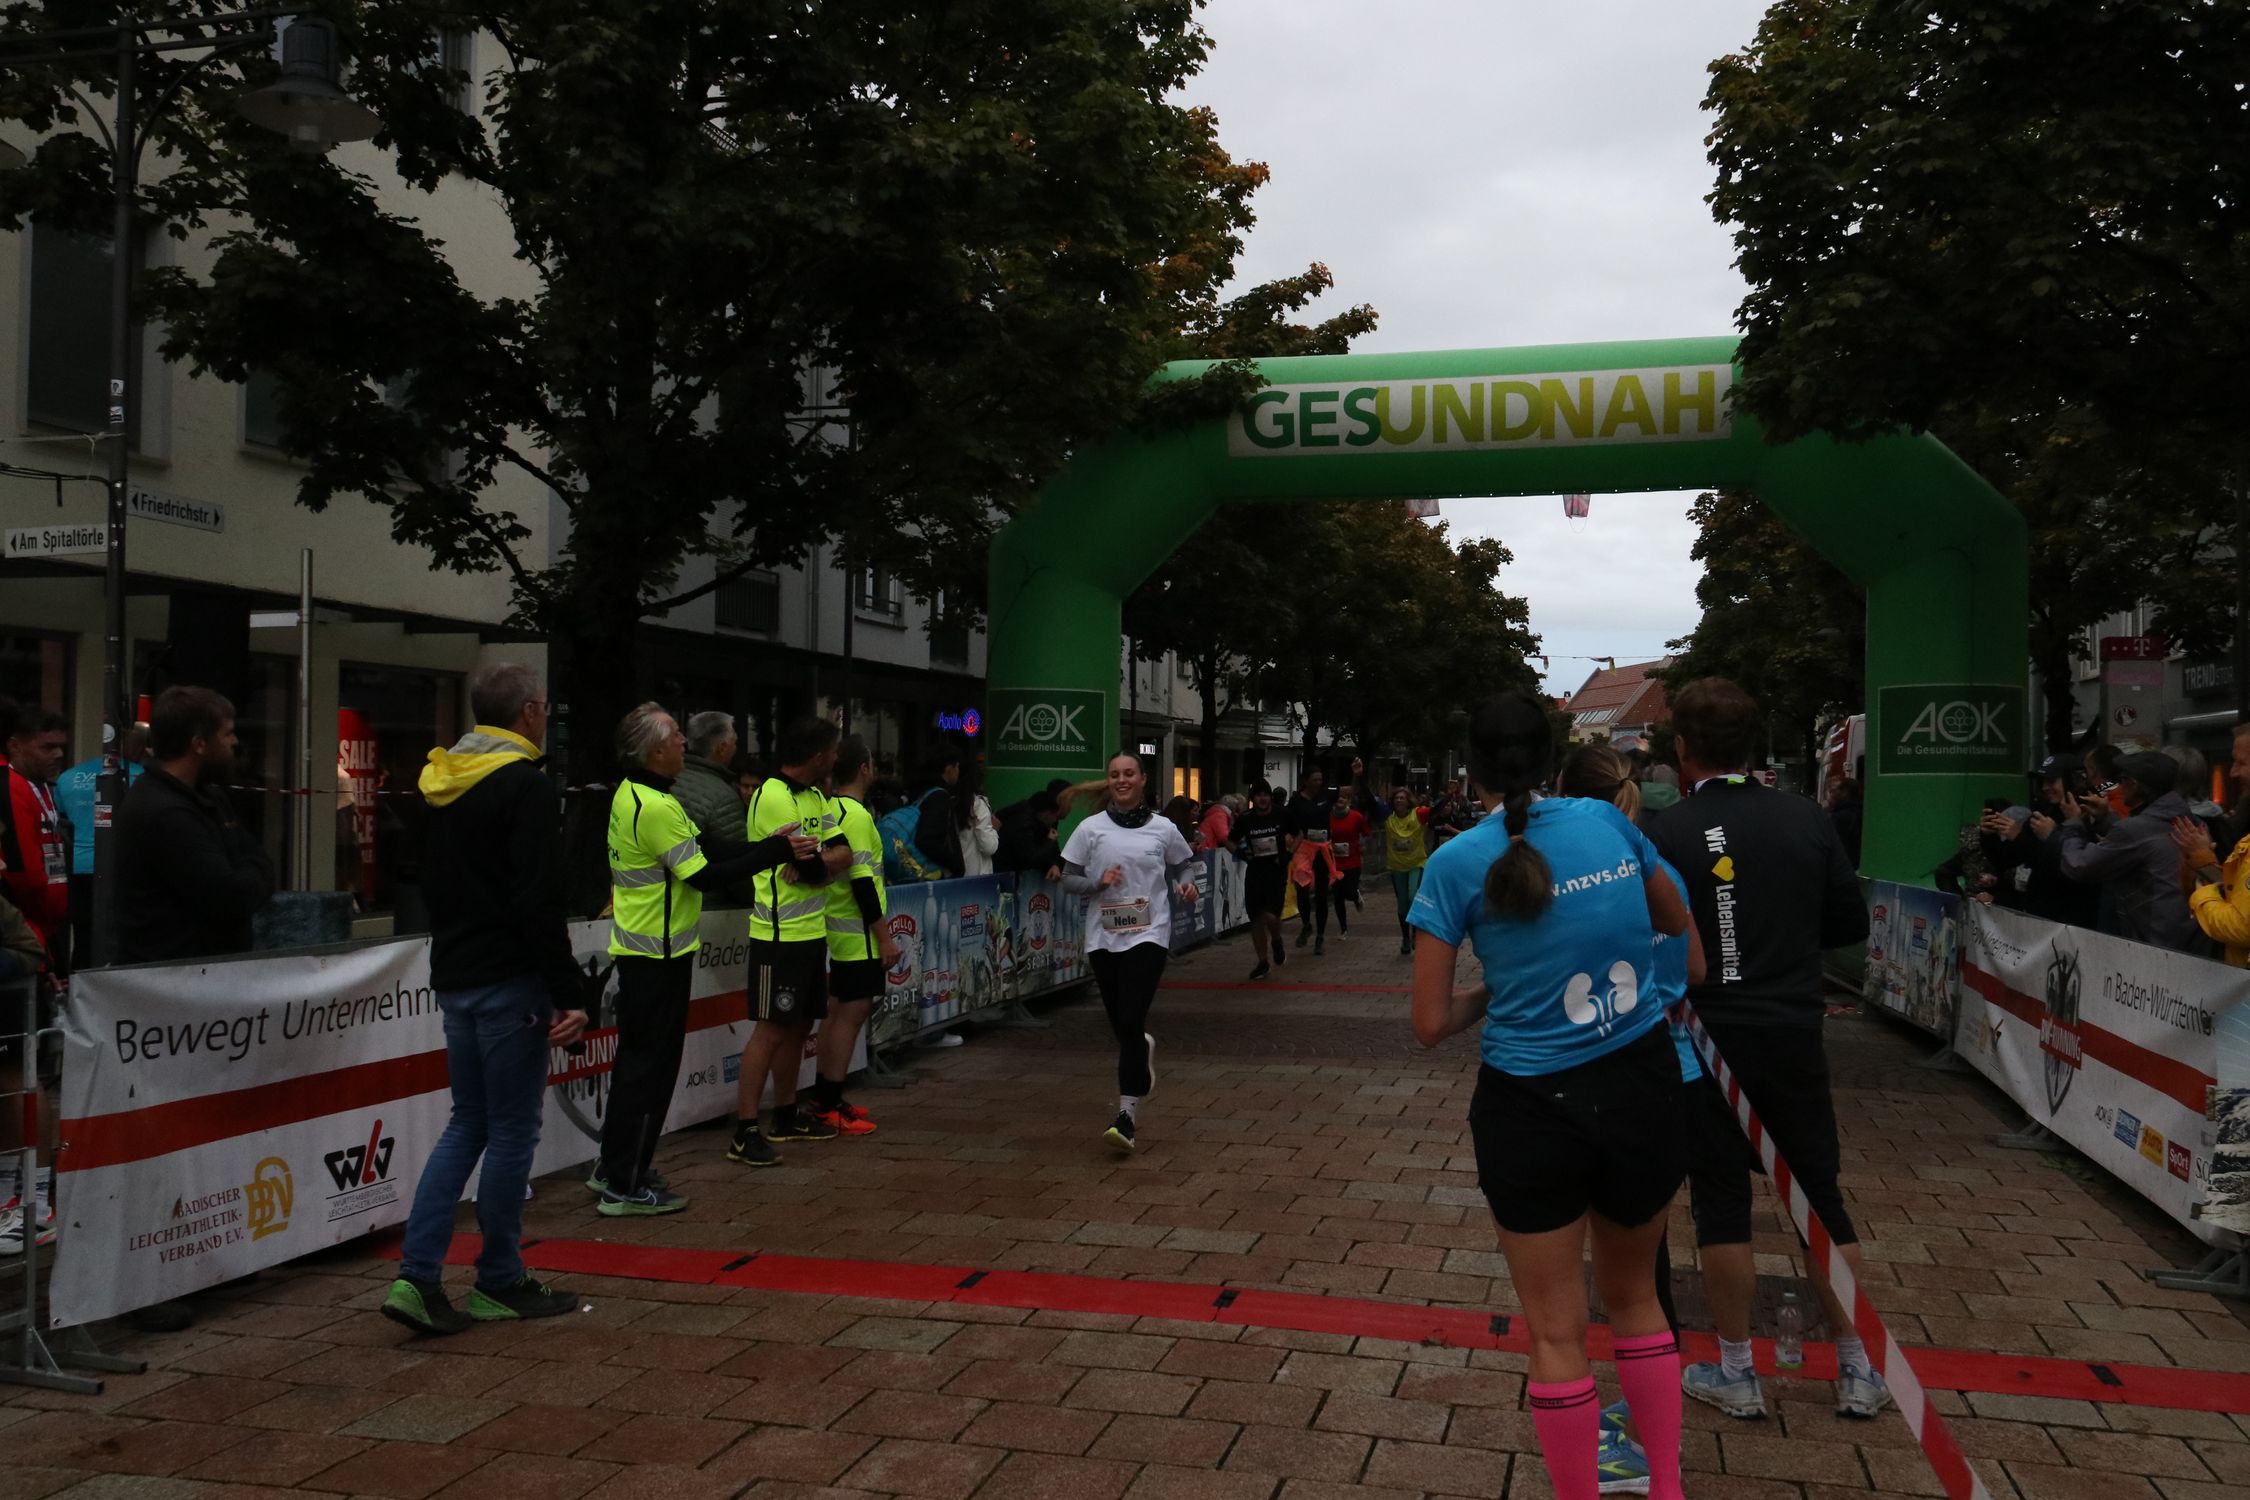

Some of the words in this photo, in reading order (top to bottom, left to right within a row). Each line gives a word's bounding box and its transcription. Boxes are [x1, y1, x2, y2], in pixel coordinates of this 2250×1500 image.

[1242, 370, 1715, 449] GESUNDNAH
[140, 494, 211, 525] Friedrichstr.
[19, 533, 38, 550] Am
[43, 528, 105, 552] Spitaltörle
[1000, 703, 1086, 742] AOK
[1900, 700, 2009, 743] AOK
[338, 738, 377, 770] SALE
[1704, 825, 1727, 854] Wir
[1114, 915, 1137, 927] Nele
[1715, 883, 1743, 985] Lebensmittel.
[116, 1007, 269, 1064] Bewegt
[686, 1071, 707, 1089] AOK
[176, 1187, 241, 1219] BADISCHER
[158, 1233, 222, 1265] VERBAND
[225, 1228, 245, 1244] E.V.
